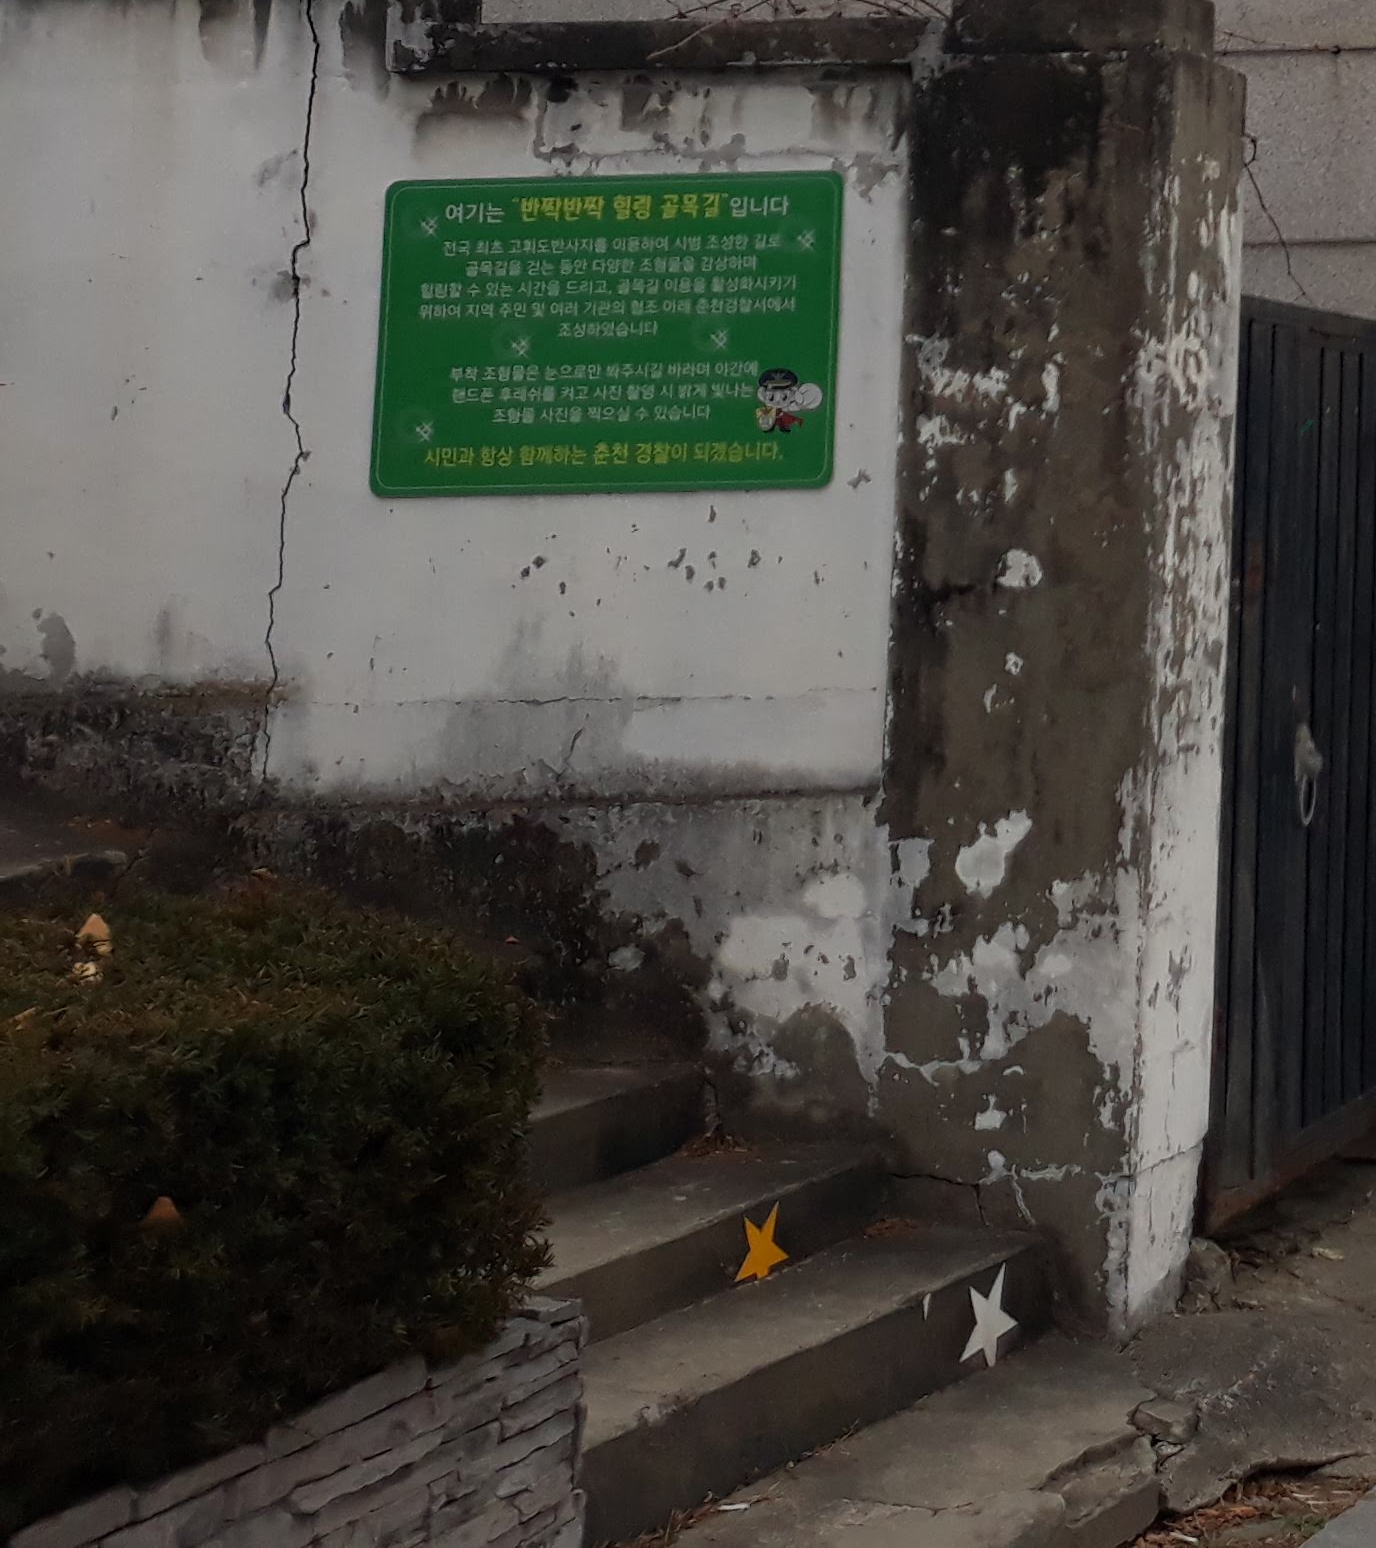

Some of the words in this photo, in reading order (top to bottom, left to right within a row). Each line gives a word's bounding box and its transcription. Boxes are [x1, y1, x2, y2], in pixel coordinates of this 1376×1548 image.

[445, 202, 505, 223] 여기는
[613, 195, 652, 220] 힐링
[443, 240, 470, 257] 전국
[674, 235, 701, 251] 시범
[706, 234, 749, 250] 조성한
[754, 233, 782, 250] 길로
[526, 259, 555, 276] 걷는
[560, 259, 588, 275] 동안
[592, 257, 635, 274] 다양한
[467, 283, 481, 298] 수
[486, 282, 513, 298] 있는
[517, 280, 561, 297] 시간을
[419, 302, 461, 319] 위하여
[465, 302, 494, 319] 지역
[532, 302, 545, 318] 및
[550, 301, 578, 317] 여러
[593, 384, 622, 401] 사진
[660, 383, 673, 400] 시
[540, 406, 583, 423] 사진을
[635, 405, 649, 421] 수
[654, 404, 711, 421] 있습니다
[424, 446, 474, 467] 시민과
[594, 442, 629, 465] 춘천
